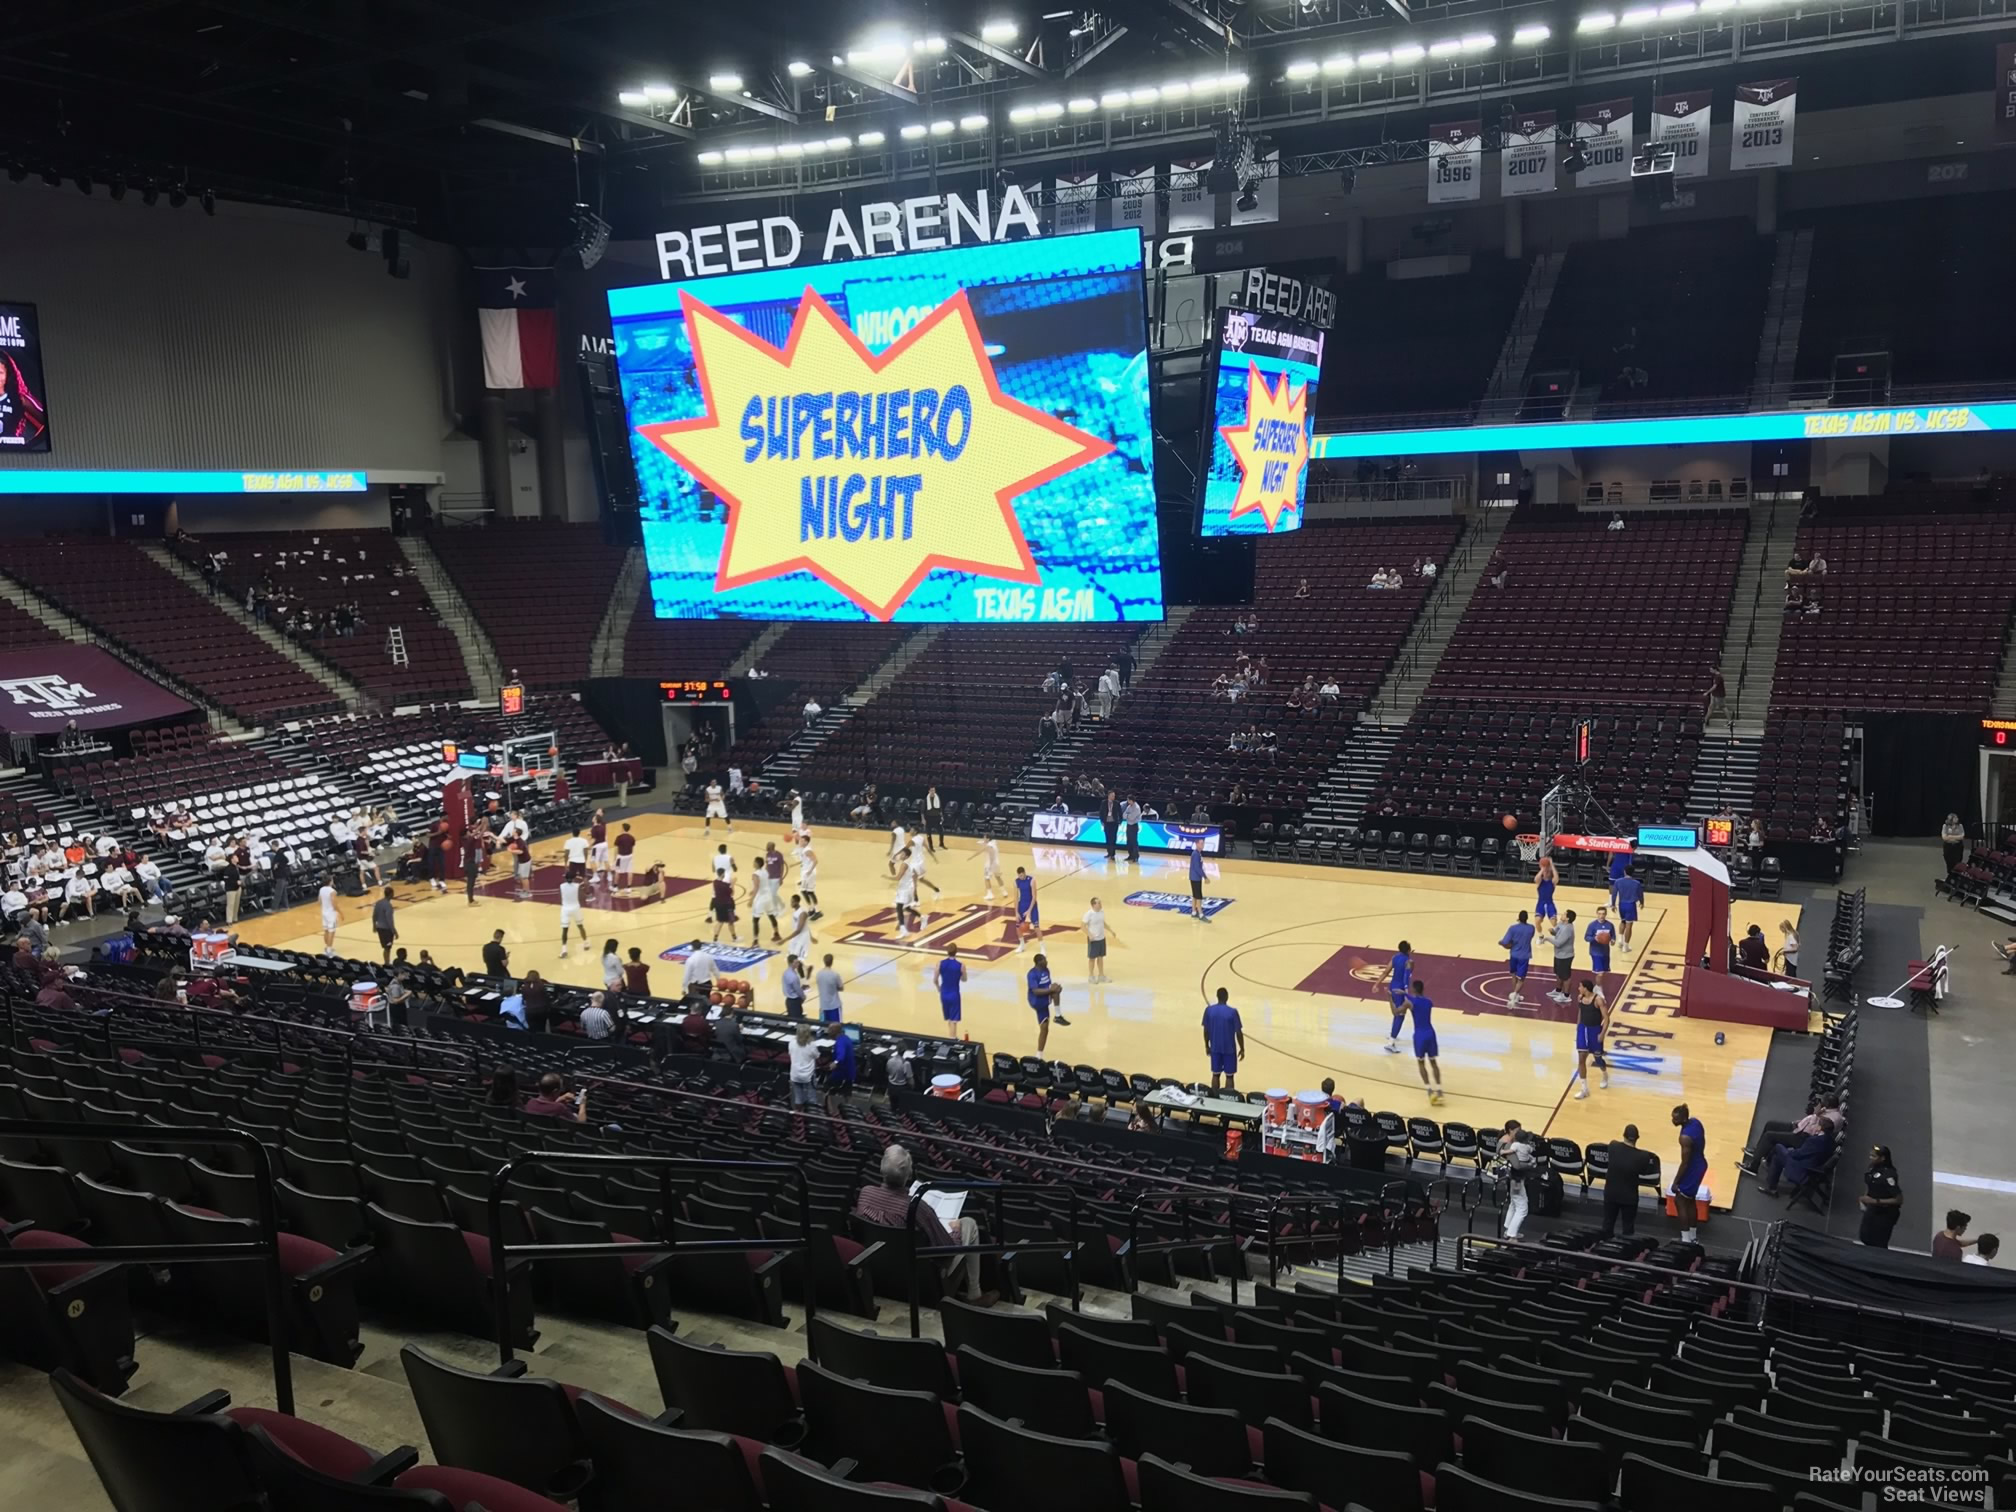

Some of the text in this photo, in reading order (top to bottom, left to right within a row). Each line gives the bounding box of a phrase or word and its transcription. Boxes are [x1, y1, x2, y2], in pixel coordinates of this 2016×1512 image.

[1748, 115, 1781, 123] TOURNAMENT
[1749, 110, 1780, 118] CONFERENCE
[1744, 120, 1785, 129] CHAMPIONSHIP
[1742, 128, 1783, 148] 2013
[1585, 147, 1624, 167] 2008
[1508, 157, 1547, 176] 2007
[1436, 166, 1472, 184] 1996
[655, 185, 1041, 280] REED ARENA
[1245, 270, 1337, 328] REED AREN
[1250, 326, 1277, 345] TEXAS
[1276, 332, 1293, 348] A&M
[740, 384, 973, 464] SUPERHERO
[1804, 407, 1971, 436] TEXAS A&M VS. UCSB
[243, 474, 275, 490] TEXAS
[1260, 460, 1290, 494] NIGHT
[800, 473, 923, 543] NIGHT
[973, 587, 1096, 622] TEXAS A&M
[504, 697, 520, 712] 30
[1996, 731, 2006, 744] 0
[1707, 820, 1732, 832] 37:58
[1644, 833, 1689, 843] PROGRESSIVE
[1711, 831, 1728, 843] 30
[1303, 1108, 1311, 1117] G
[1377, 1118, 1399, 1126] MUSCLE
[1446, 1129, 1469, 1137] MUSCLE
[1550, 1144, 1574, 1153] MUSCLE
[1555, 1150, 1570, 1158] MILK
[1590, 1149, 1609, 1157] MUSC
[72, 1303, 81, 1314] N
